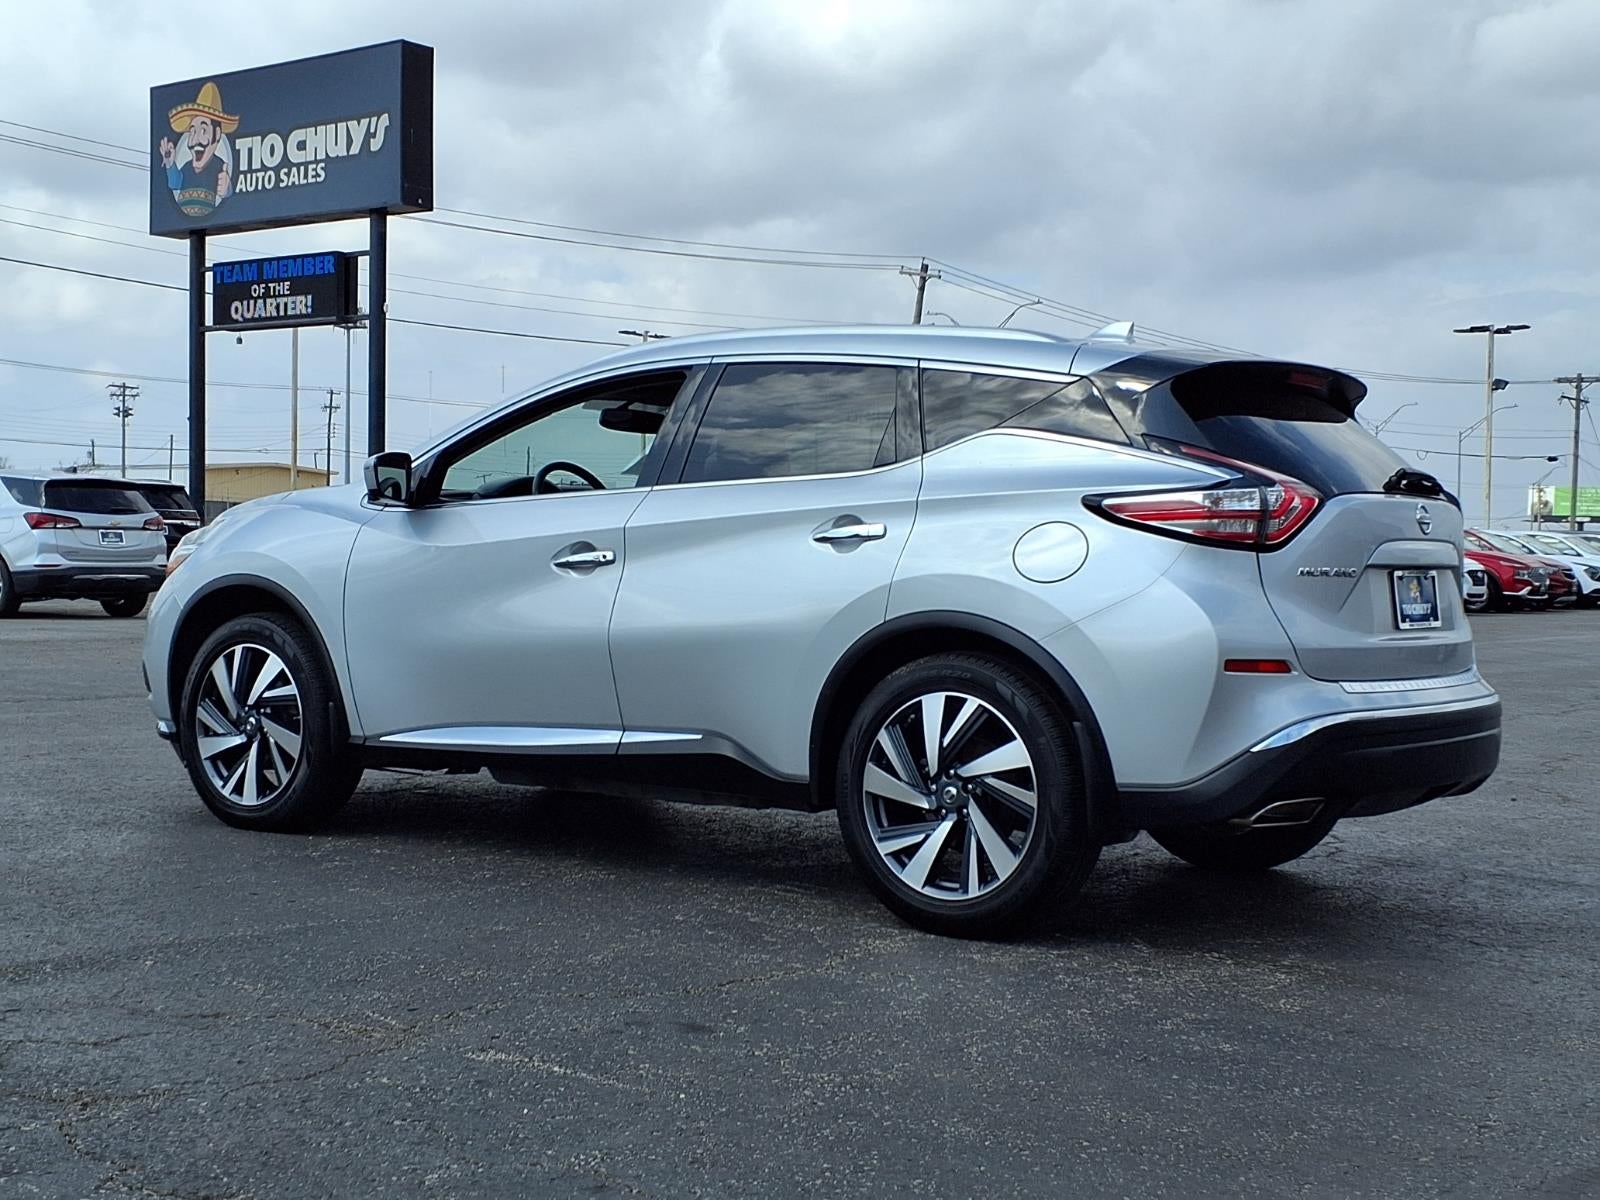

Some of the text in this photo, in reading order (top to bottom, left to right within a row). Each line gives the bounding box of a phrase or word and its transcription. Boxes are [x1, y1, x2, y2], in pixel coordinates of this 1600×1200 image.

[235, 113, 390, 171] TIO CHUY'S
[235, 162, 326, 193] AUTO SALES
[214, 255, 335, 284] TEAM MEMBER
[251, 281, 291, 297] OF THE
[230, 294, 313, 322] QUARTER!
[1297, 567, 1358, 578] MURANO
